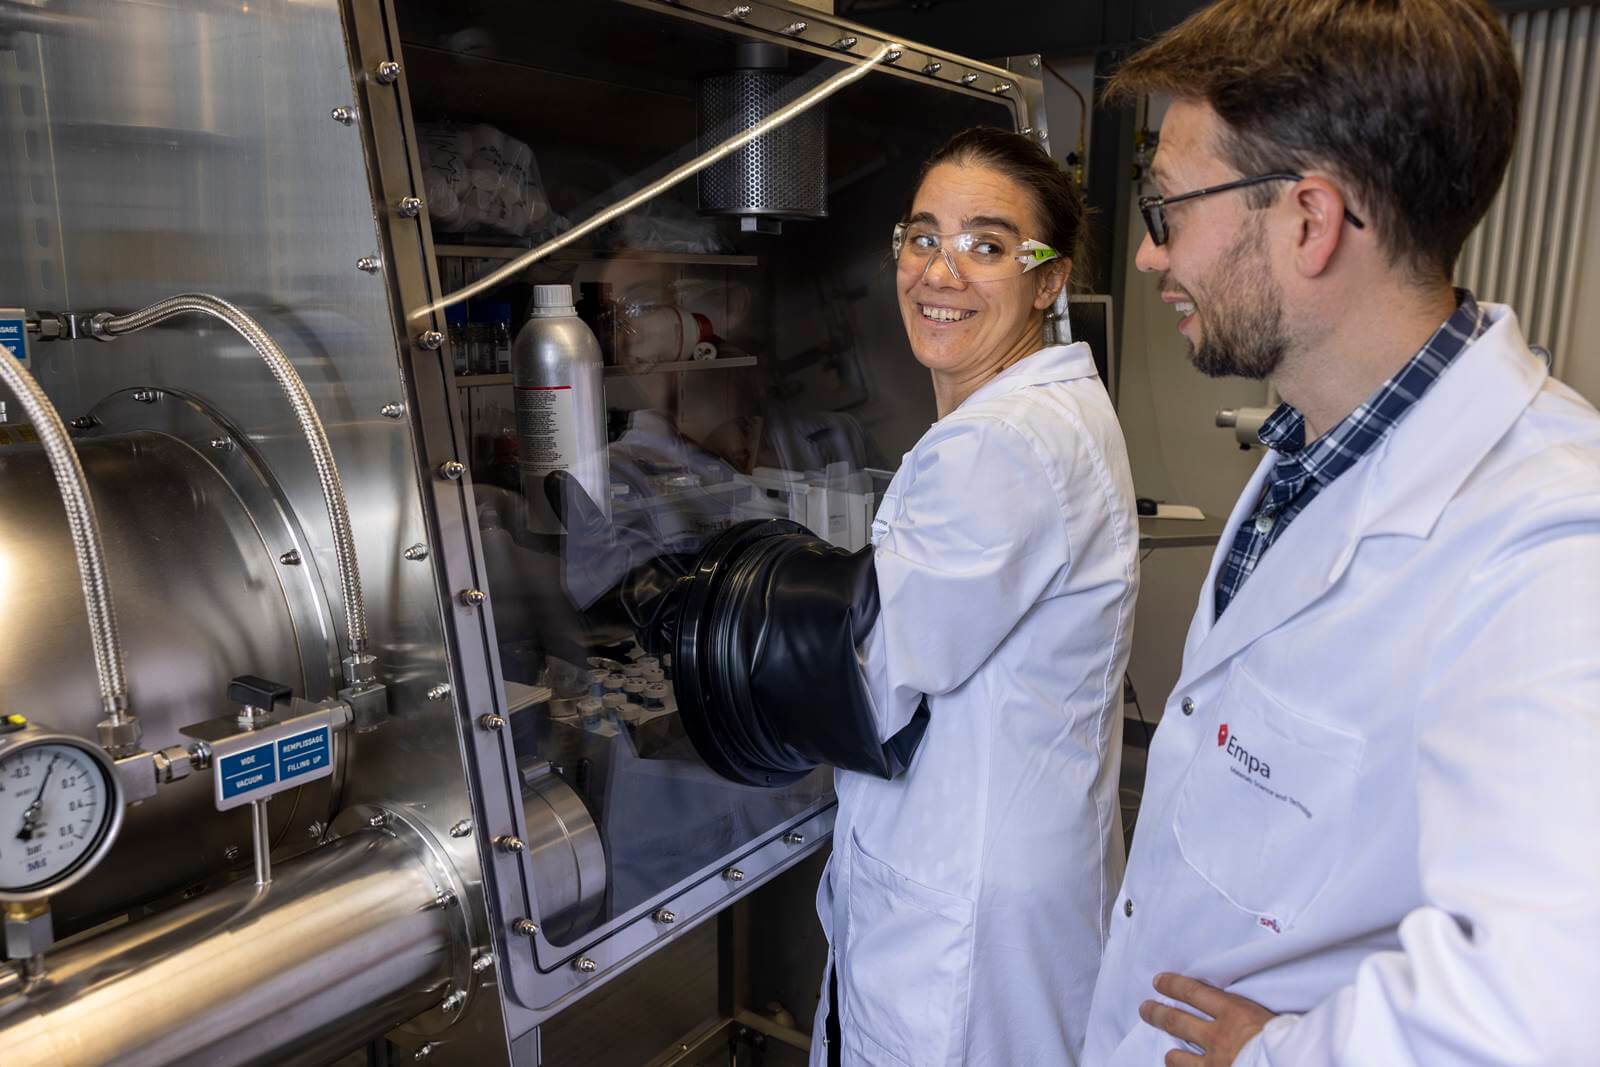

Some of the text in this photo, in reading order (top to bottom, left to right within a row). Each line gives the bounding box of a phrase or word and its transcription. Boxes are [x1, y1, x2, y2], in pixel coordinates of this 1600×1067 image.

[282, 734, 324, 753] REMPLISSAGE
[287, 755, 322, 772] FILLING UP
[1226, 735, 1271, 779] Empa
[61, 776, 76, 789] 0.2
[235, 774, 263, 789] VACUUM
[69, 799, 83, 811] 0.4
